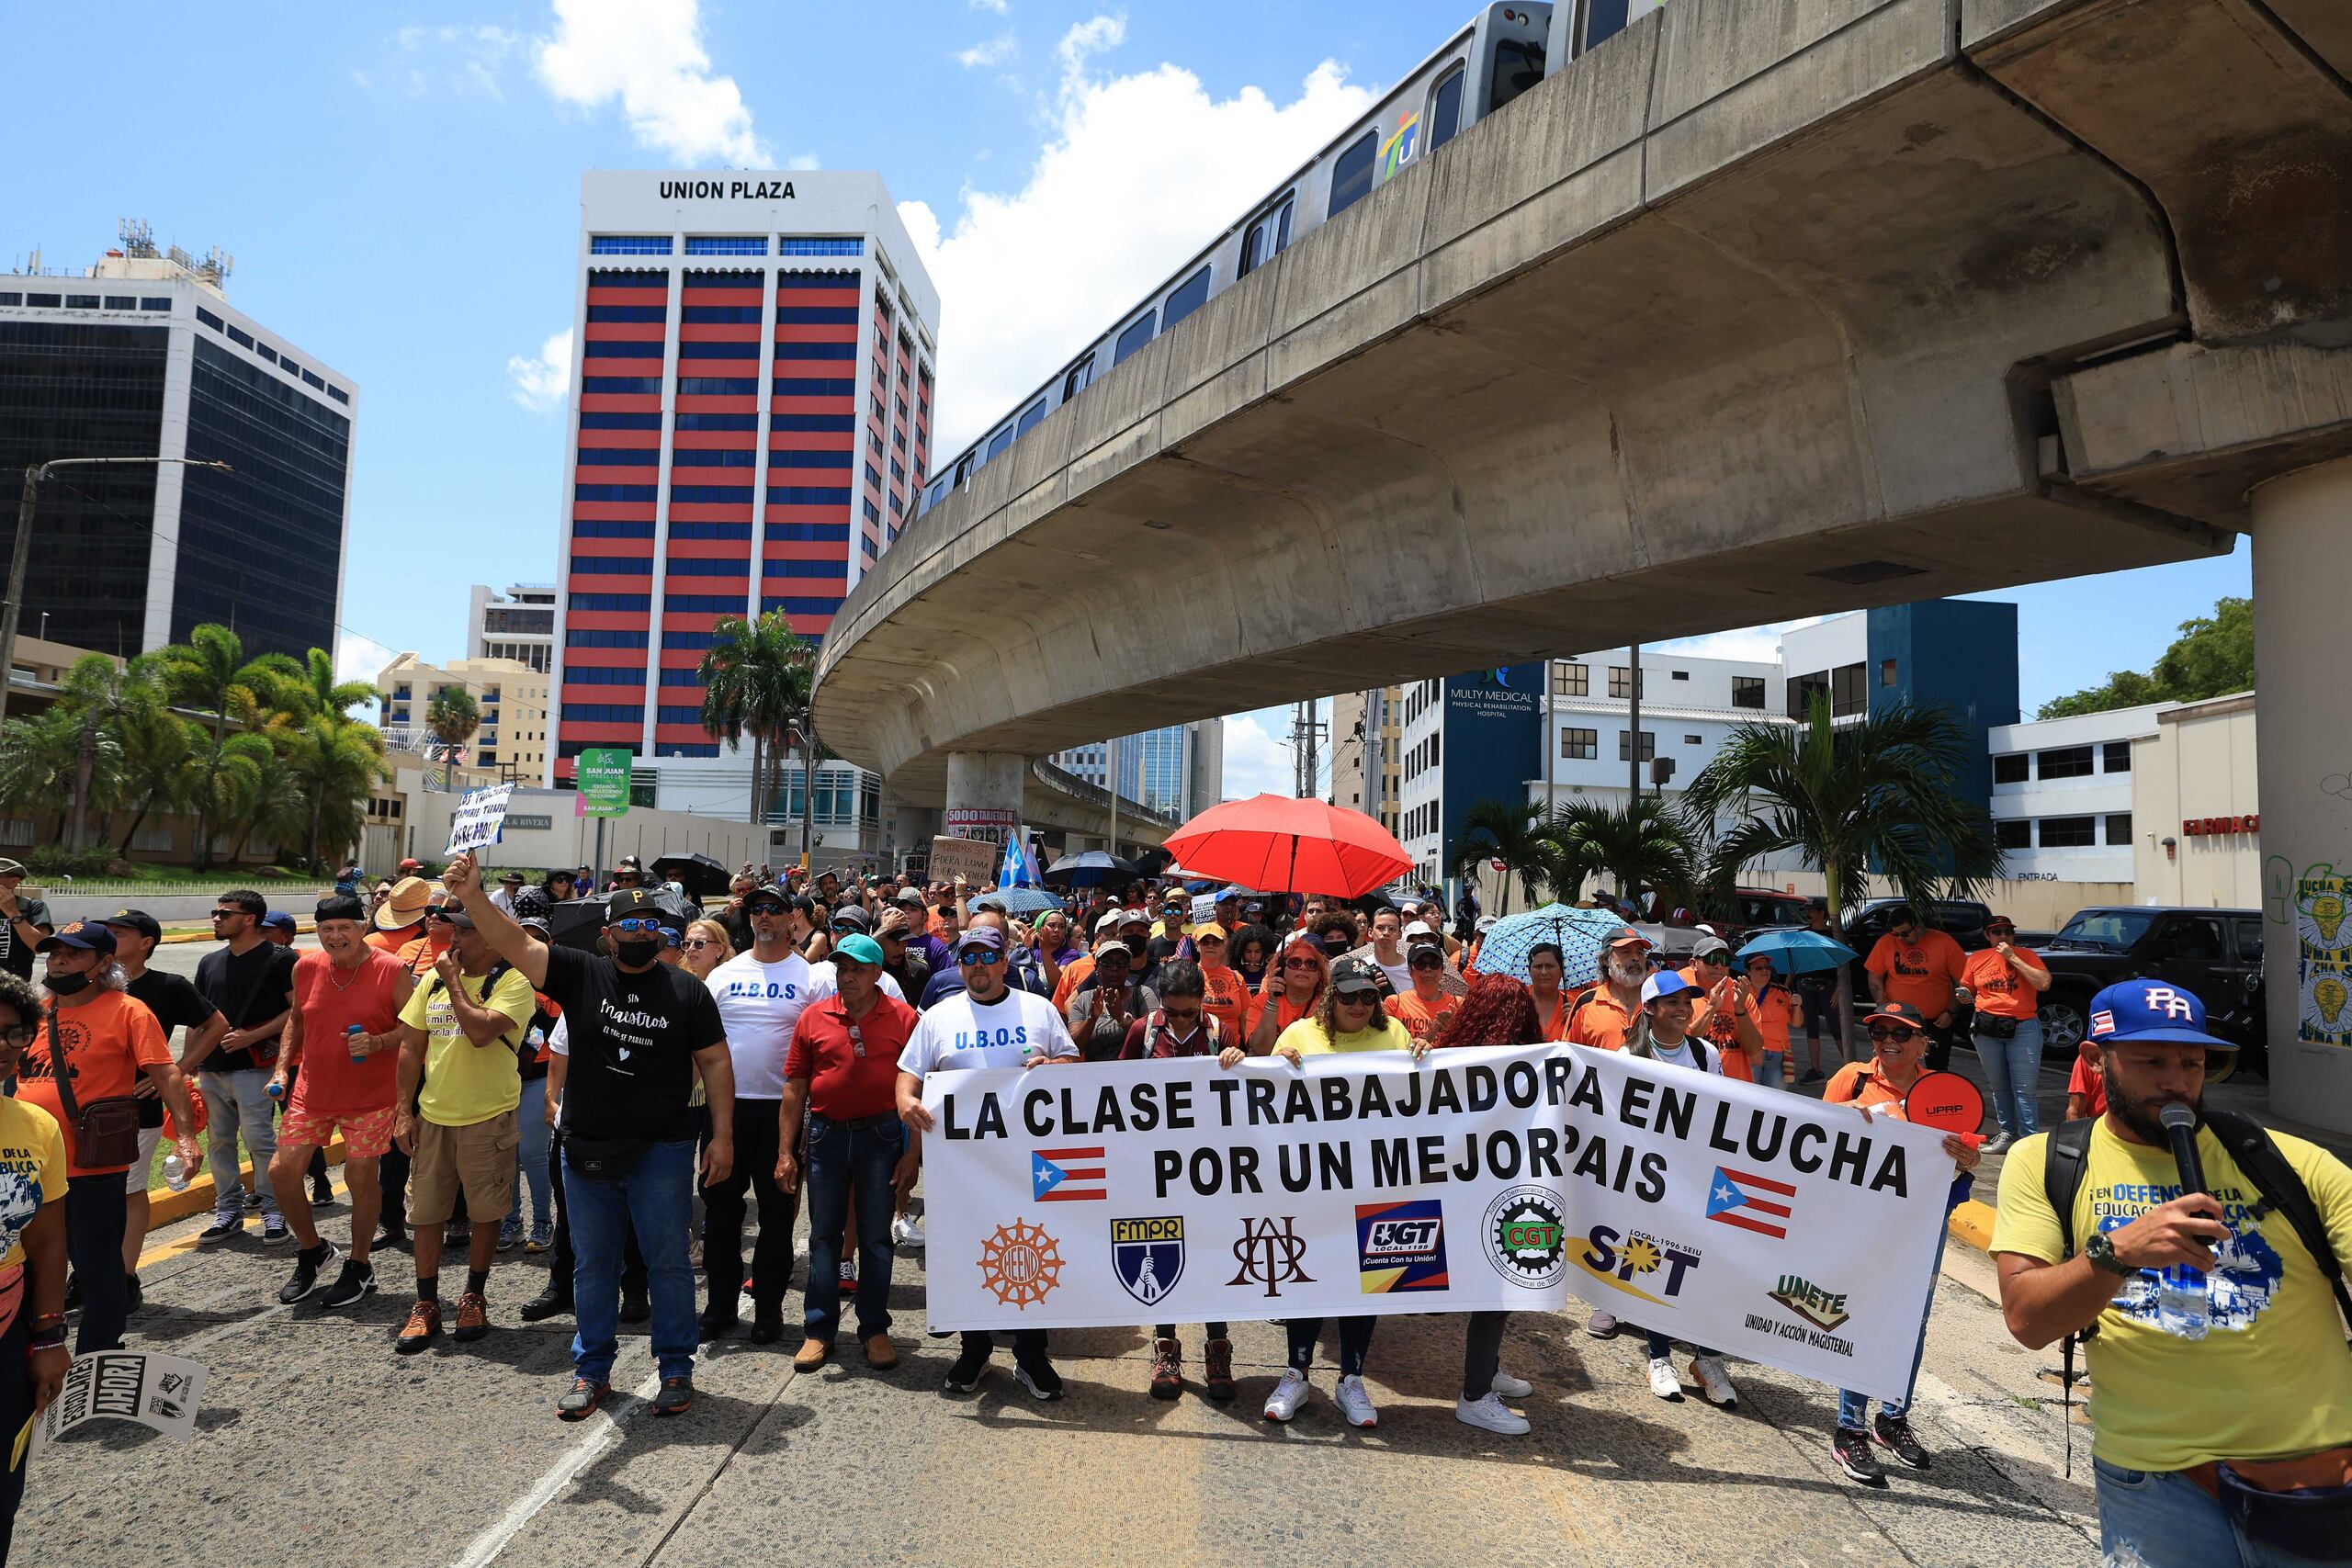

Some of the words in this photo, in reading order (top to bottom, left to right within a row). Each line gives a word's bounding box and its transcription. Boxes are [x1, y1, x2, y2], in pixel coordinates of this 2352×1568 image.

[660, 181, 724, 199] UNION
[730, 181, 796, 199] PLAZA
[1451, 688, 1484, 699] MULTY
[1485, 690, 1533, 704] MEDICAL
[1452, 701, 1482, 709] PHYSICAL
[1483, 703, 1532, 712] REHABILITATION
[1476, 710, 1507, 718] HOSPITAL
[520, 818, 549, 827] RIVERA
[948, 809, 978, 821] 5000
[978, 810, 1007, 821] TARJETAS
[1007, 810, 1013, 822] DE
[930, 865, 956, 877] FUERA
[933, 853, 960, 866] FUERA
[965, 857, 989, 870] LUMA
[2018, 873, 2058, 882] ENTRADA
[632, 890, 644, 904] P
[2299, 879, 2335, 900] LUCHA
[2299, 938, 2332, 962] LUMA
[628, 993, 639, 1004] SIN
[729, 981, 797, 1000] U.B.O.S
[428, 1001, 454, 1010] Aume
[600, 998, 670, 1030] Maestros
[431, 1014, 443, 1024] mi
[603, 1025, 609, 1034] EL
[620, 1032, 627, 1042] SE
[628, 1034, 653, 1047] PARALIZA
[956, 1025, 1027, 1050] U.B.O.S
[2301, 1019, 2334, 1046] LUMA
[1926, 1104, 1963, 1115] UPRP
[944, 1092, 1008, 1140] LA
[1023, 1081, 1195, 1136] CLASE
[1209, 1056, 1604, 1127] TRABAJADORA
[1620, 1077, 1698, 1141] EN
[1709, 1101, 1908, 1199] LUCHA
[3, 1148, 16, 1158] DE
[17, 1148, 31, 1158] LA
[1154, 1146, 1263, 1198] POR
[1278, 1140, 1353, 1193] UN
[1371, 1127, 1564, 1189] MEJOR
[1565, 1123, 1668, 1204] PAIS
[1487, 1195, 1507, 1214] Justicia
[1505, 1187, 1544, 1198] Democracia
[2113, 1183, 2183, 1205] DEFENS
[2225, 1188, 2244, 1201] LA
[1117, 1219, 1178, 1240] FMPR
[1373, 1222, 1438, 1247] UGT
[1509, 1226, 1555, 1247] CGT
[1363, 1258, 1389, 1266] ¡Cuenta
[1390, 1256, 1404, 1264] Con
[1405, 1255, 1413, 1263] tu
[1414, 1254, 1437, 1263] Unión!
[1682, 1245, 1702, 1257] SEIU
[1491, 1255, 1510, 1277] Central
[1510, 1274, 1535, 1287] General
[1536, 1279, 1545, 1287] de
[1777, 1274, 1848, 1314] UNETE
[1745, 1314, 1773, 1334] UNIDAD
[1773, 1321, 1781, 1336] Y
[1778, 1324, 1808, 1343] ACCIÓN
[1807, 1330, 1854, 1358] MAGISTERIAL
[62, 1356, 95, 1428] ESCOLARES
[96, 1356, 144, 1416] AHORA
